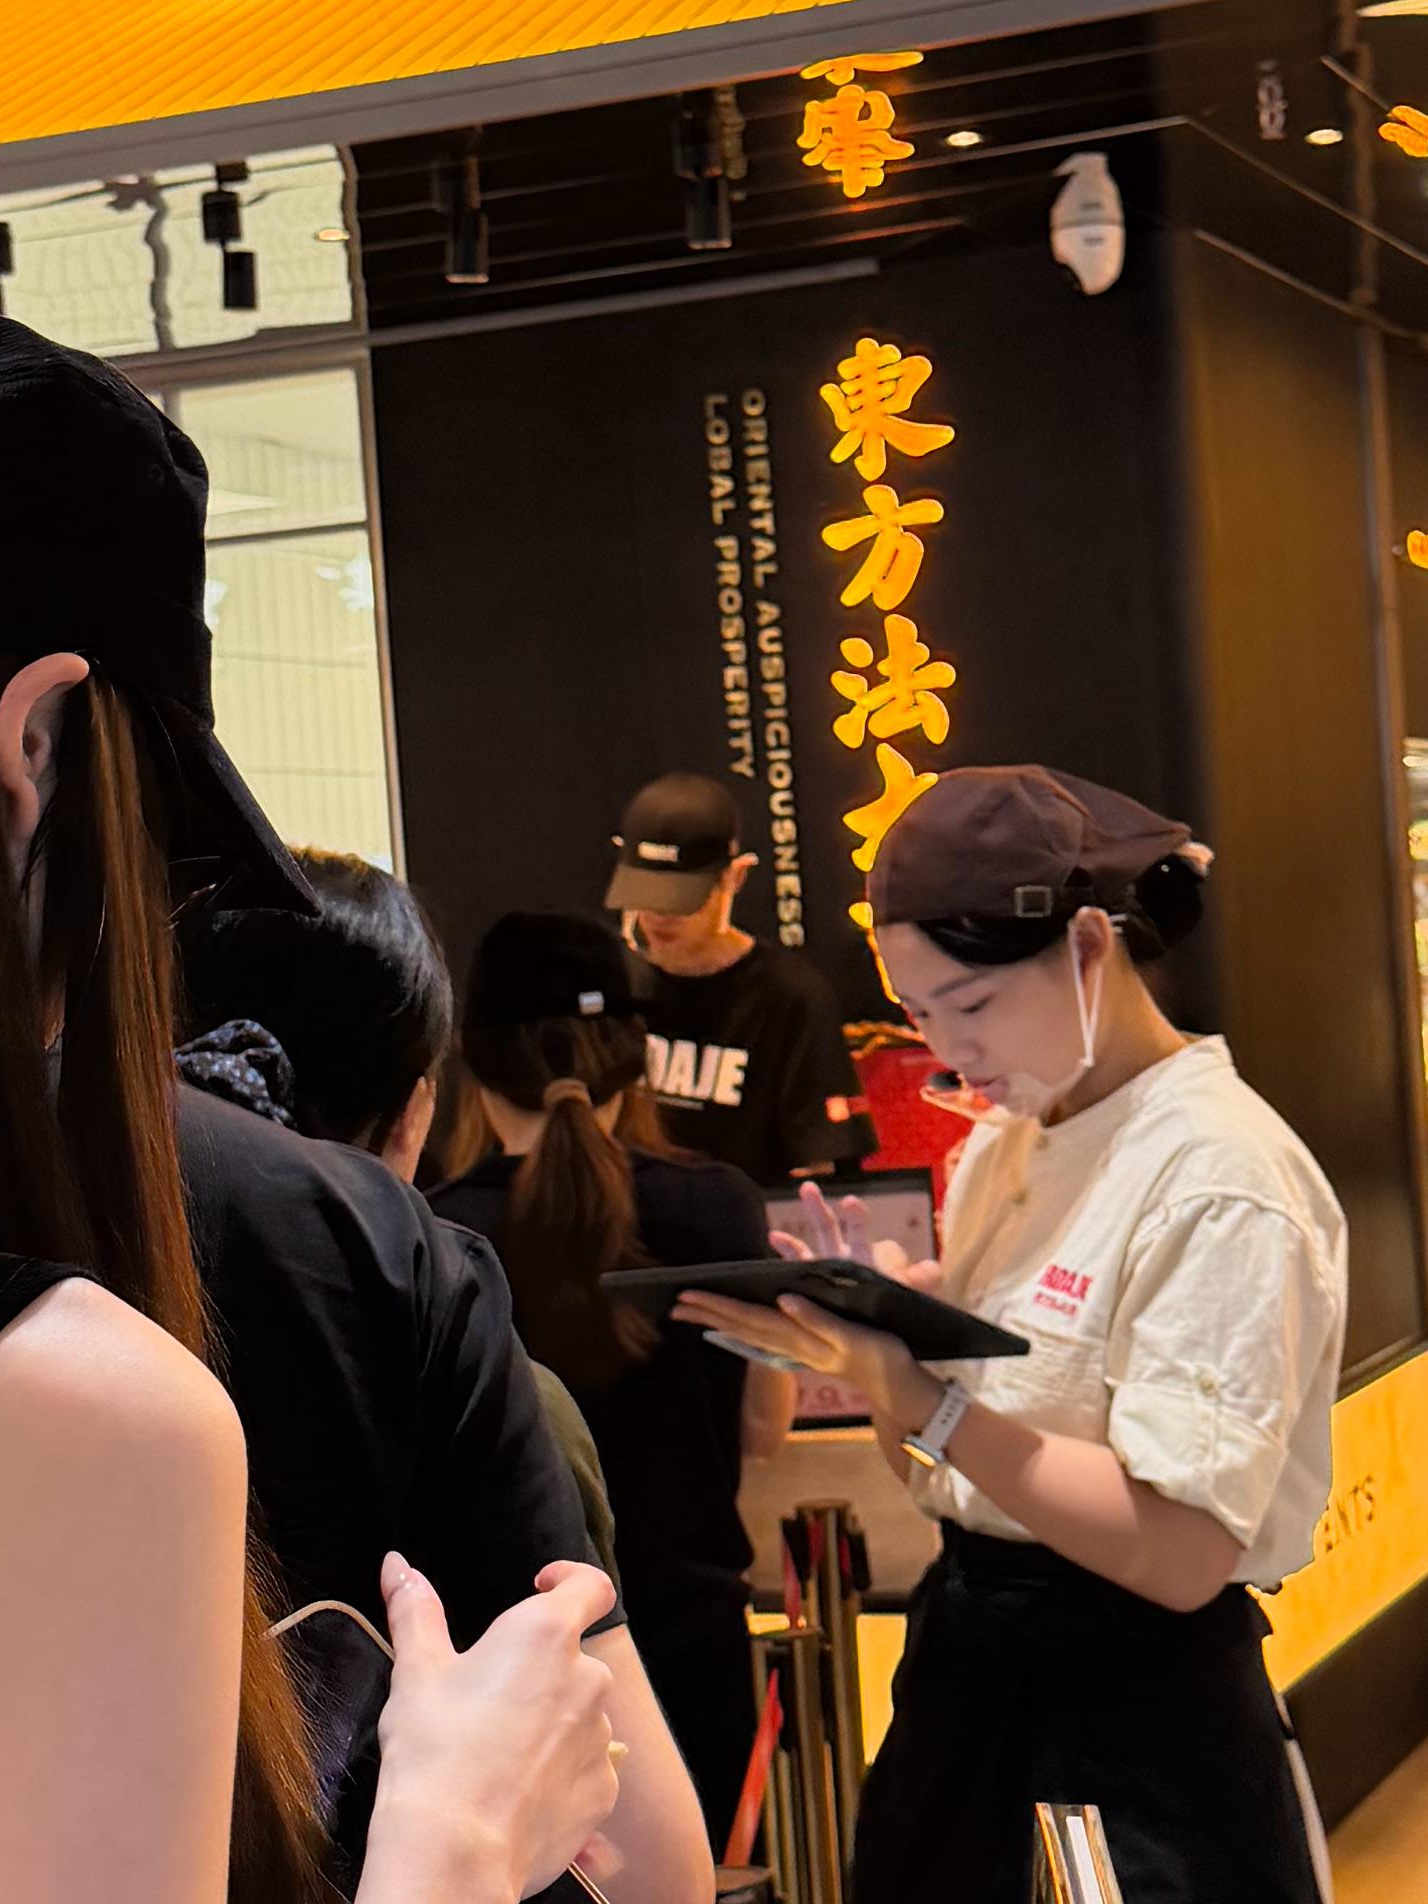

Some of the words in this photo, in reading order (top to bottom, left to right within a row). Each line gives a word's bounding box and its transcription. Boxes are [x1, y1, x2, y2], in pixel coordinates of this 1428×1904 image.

[742, 388, 779, 588] ORIENTAL
[714, 534, 756, 778] PROSPERITY
[756, 599, 805, 946] AUSPICIOUSNESS
[819, 337, 955, 1004] 東方法
[638, 1032, 749, 1107] DAJE
